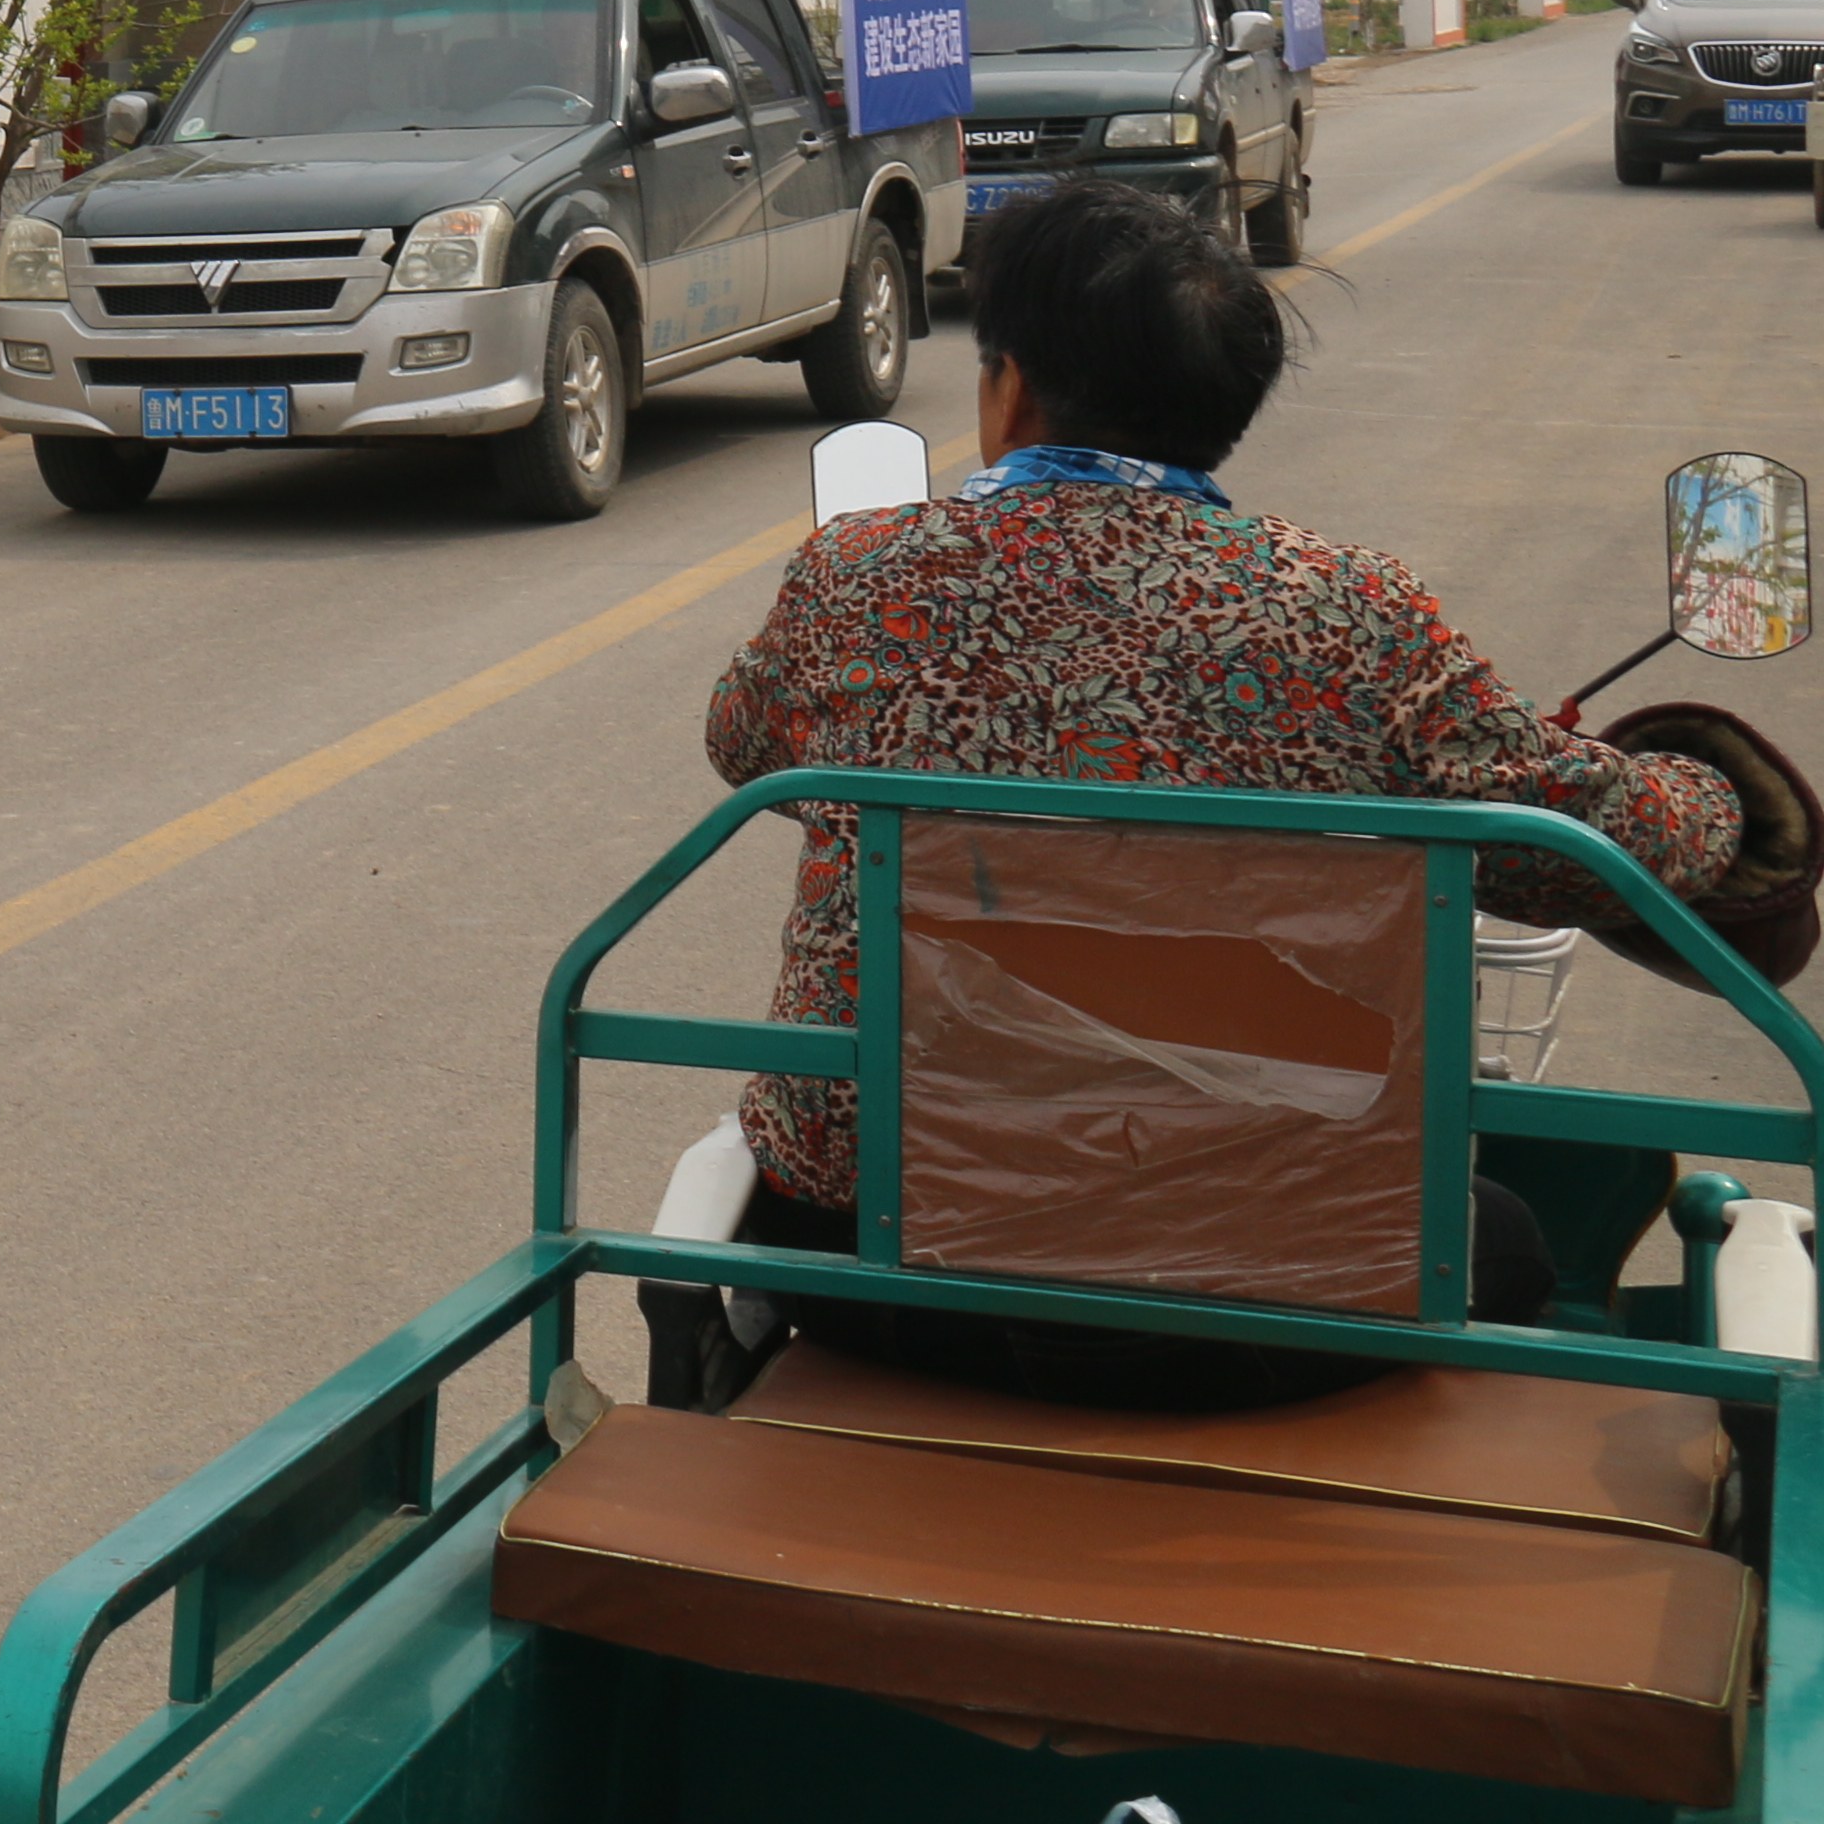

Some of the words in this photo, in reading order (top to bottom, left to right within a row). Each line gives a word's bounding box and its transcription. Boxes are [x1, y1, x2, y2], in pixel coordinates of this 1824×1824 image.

[863, 8, 964, 78] 建设生态新家园
[964, 130, 1035, 146] ISUZU
